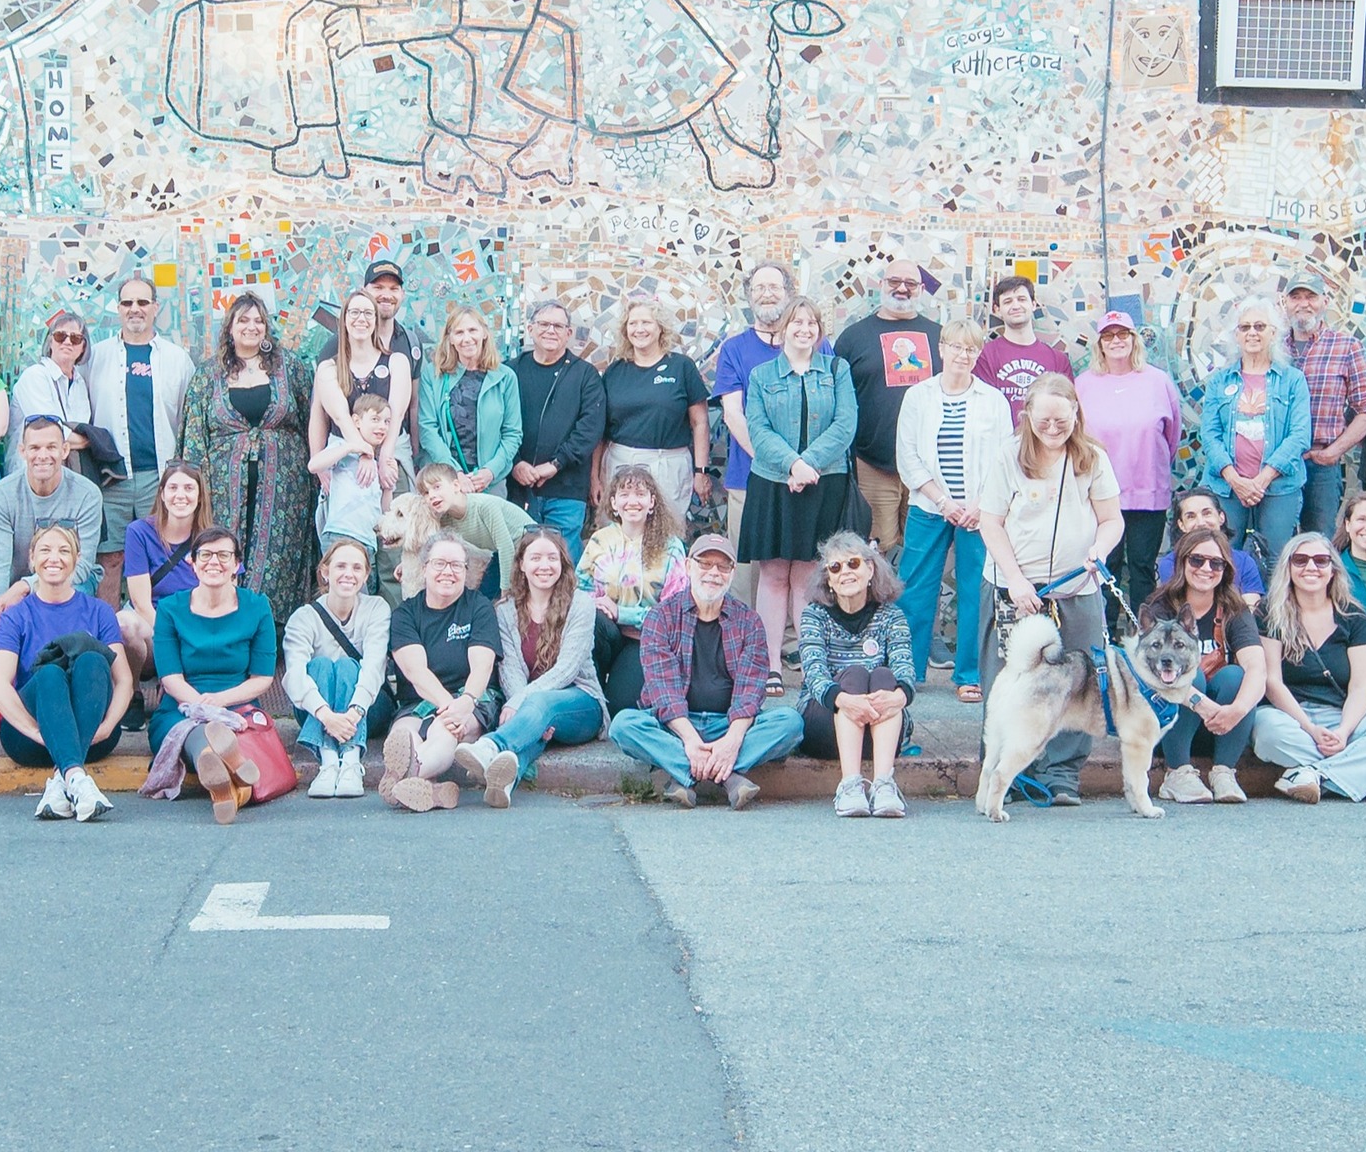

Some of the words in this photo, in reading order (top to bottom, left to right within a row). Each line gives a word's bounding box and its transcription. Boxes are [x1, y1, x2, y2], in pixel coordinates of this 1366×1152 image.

[48, 70, 69, 170] HOME
[609, 214, 680, 234] Peace
[996, 358, 1047, 381] NORWIC
